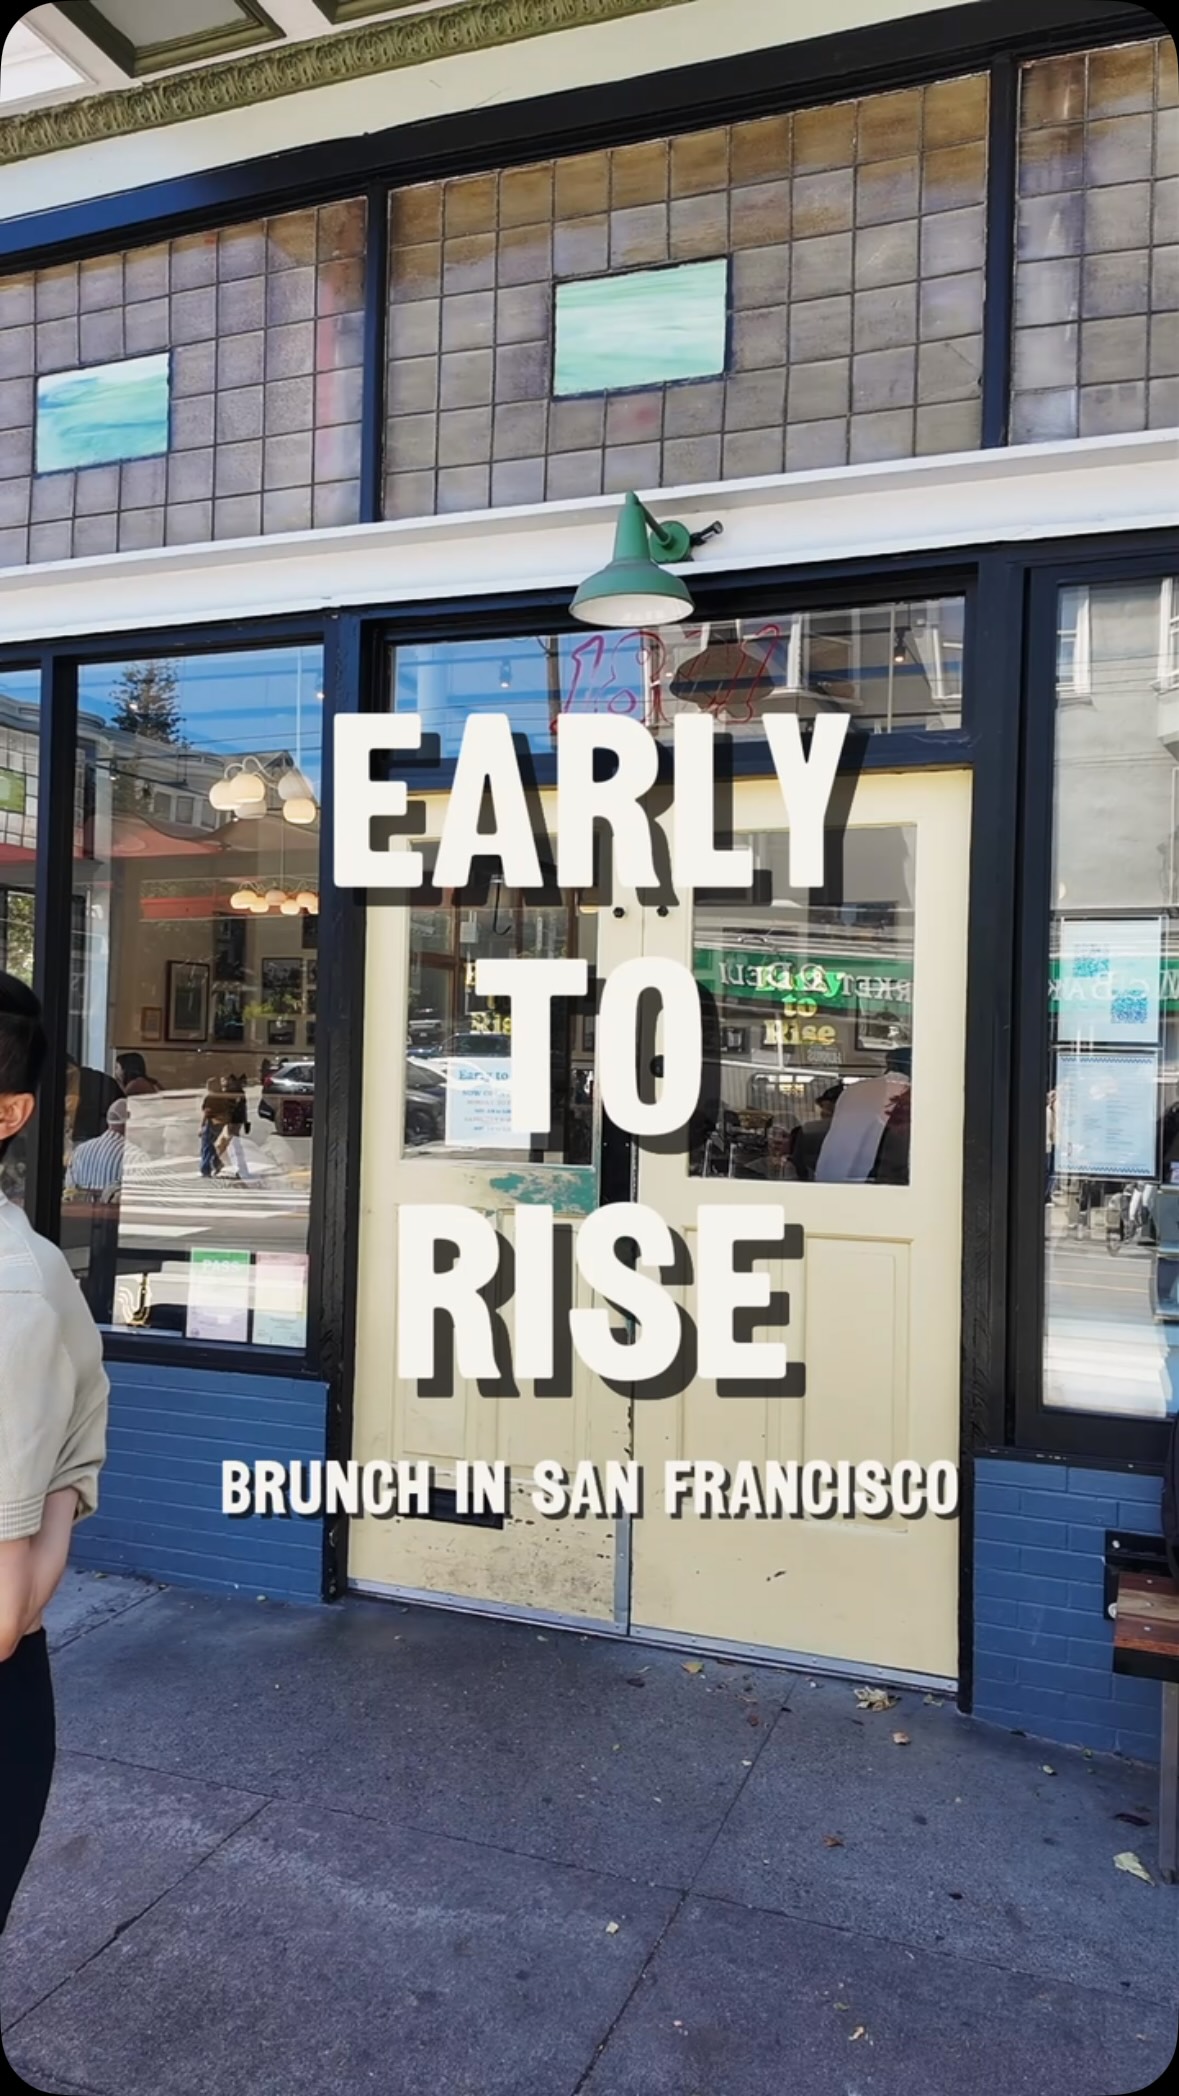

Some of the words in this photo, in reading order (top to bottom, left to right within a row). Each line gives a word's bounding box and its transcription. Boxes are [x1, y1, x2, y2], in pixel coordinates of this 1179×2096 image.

[781, 994, 817, 1017] to
[763, 1019, 836, 1045] Rise
[203, 1259, 240, 1273] PASS
